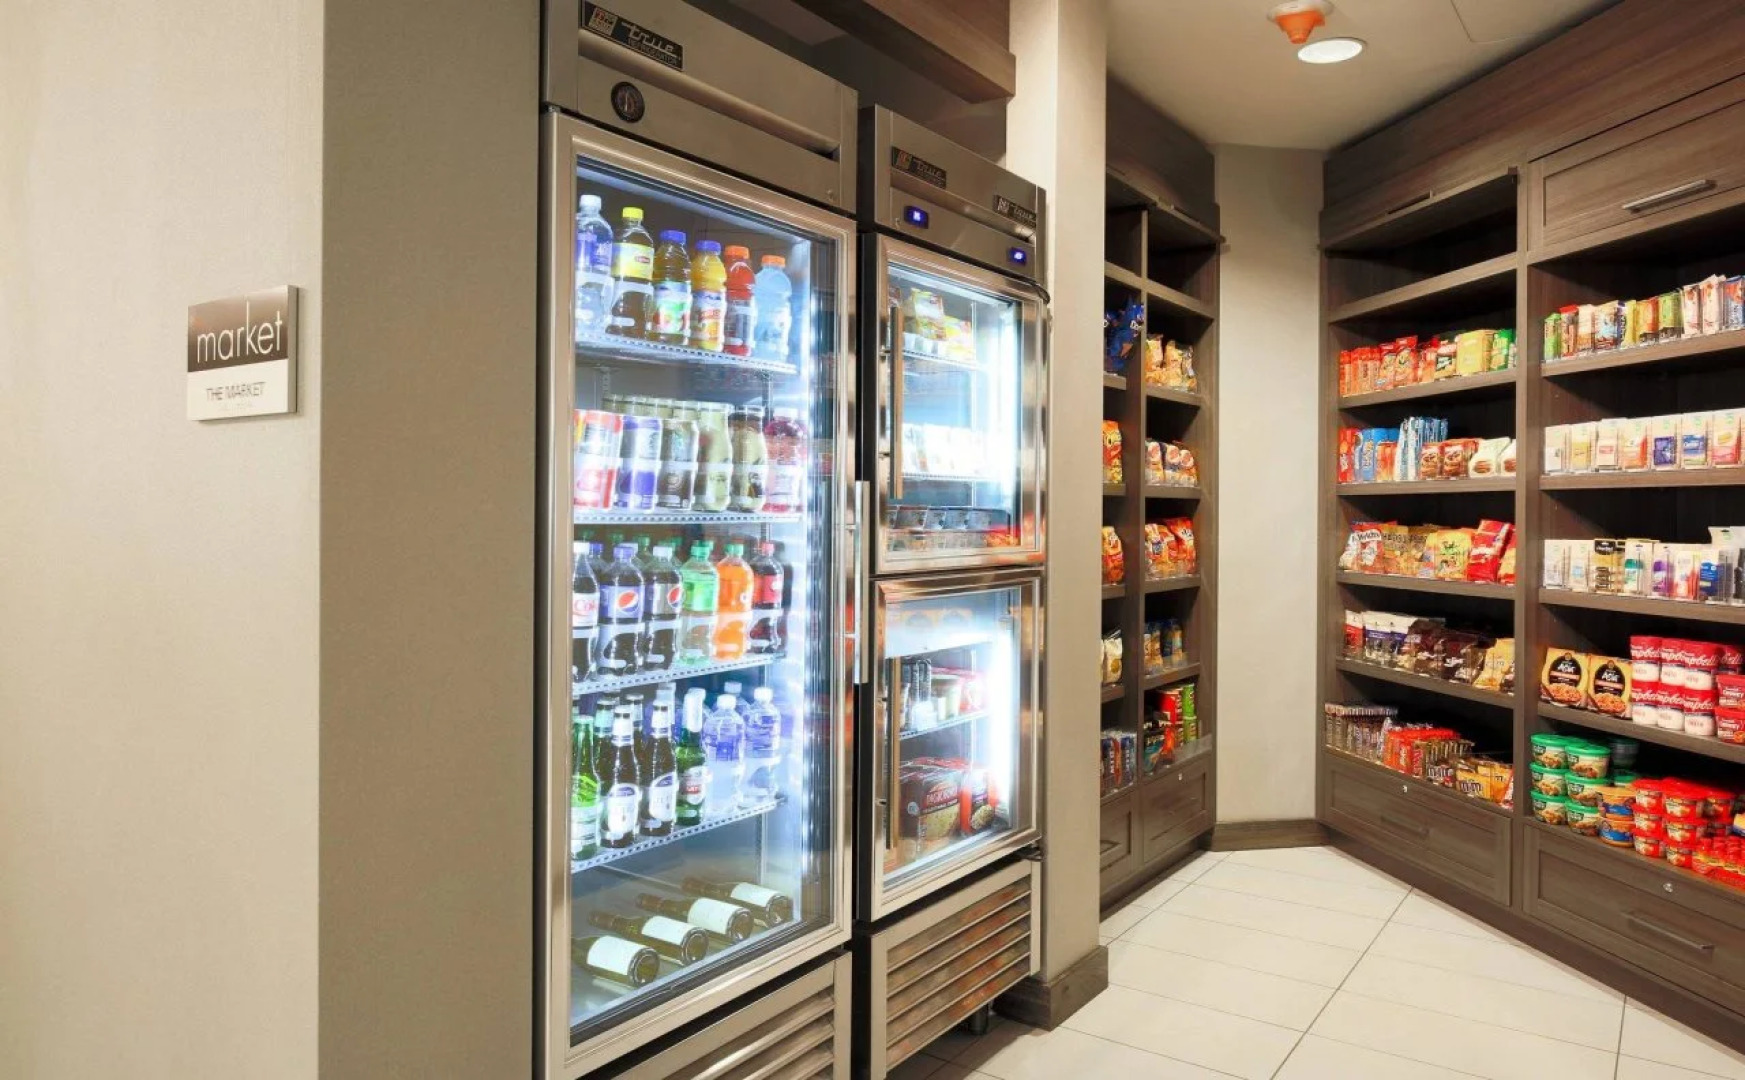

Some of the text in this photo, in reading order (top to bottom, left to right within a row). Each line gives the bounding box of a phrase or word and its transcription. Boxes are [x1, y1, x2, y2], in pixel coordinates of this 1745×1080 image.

[621, 22, 678, 57] true
[197, 300, 283, 363] market
[206, 381, 266, 401] THE MARKET
